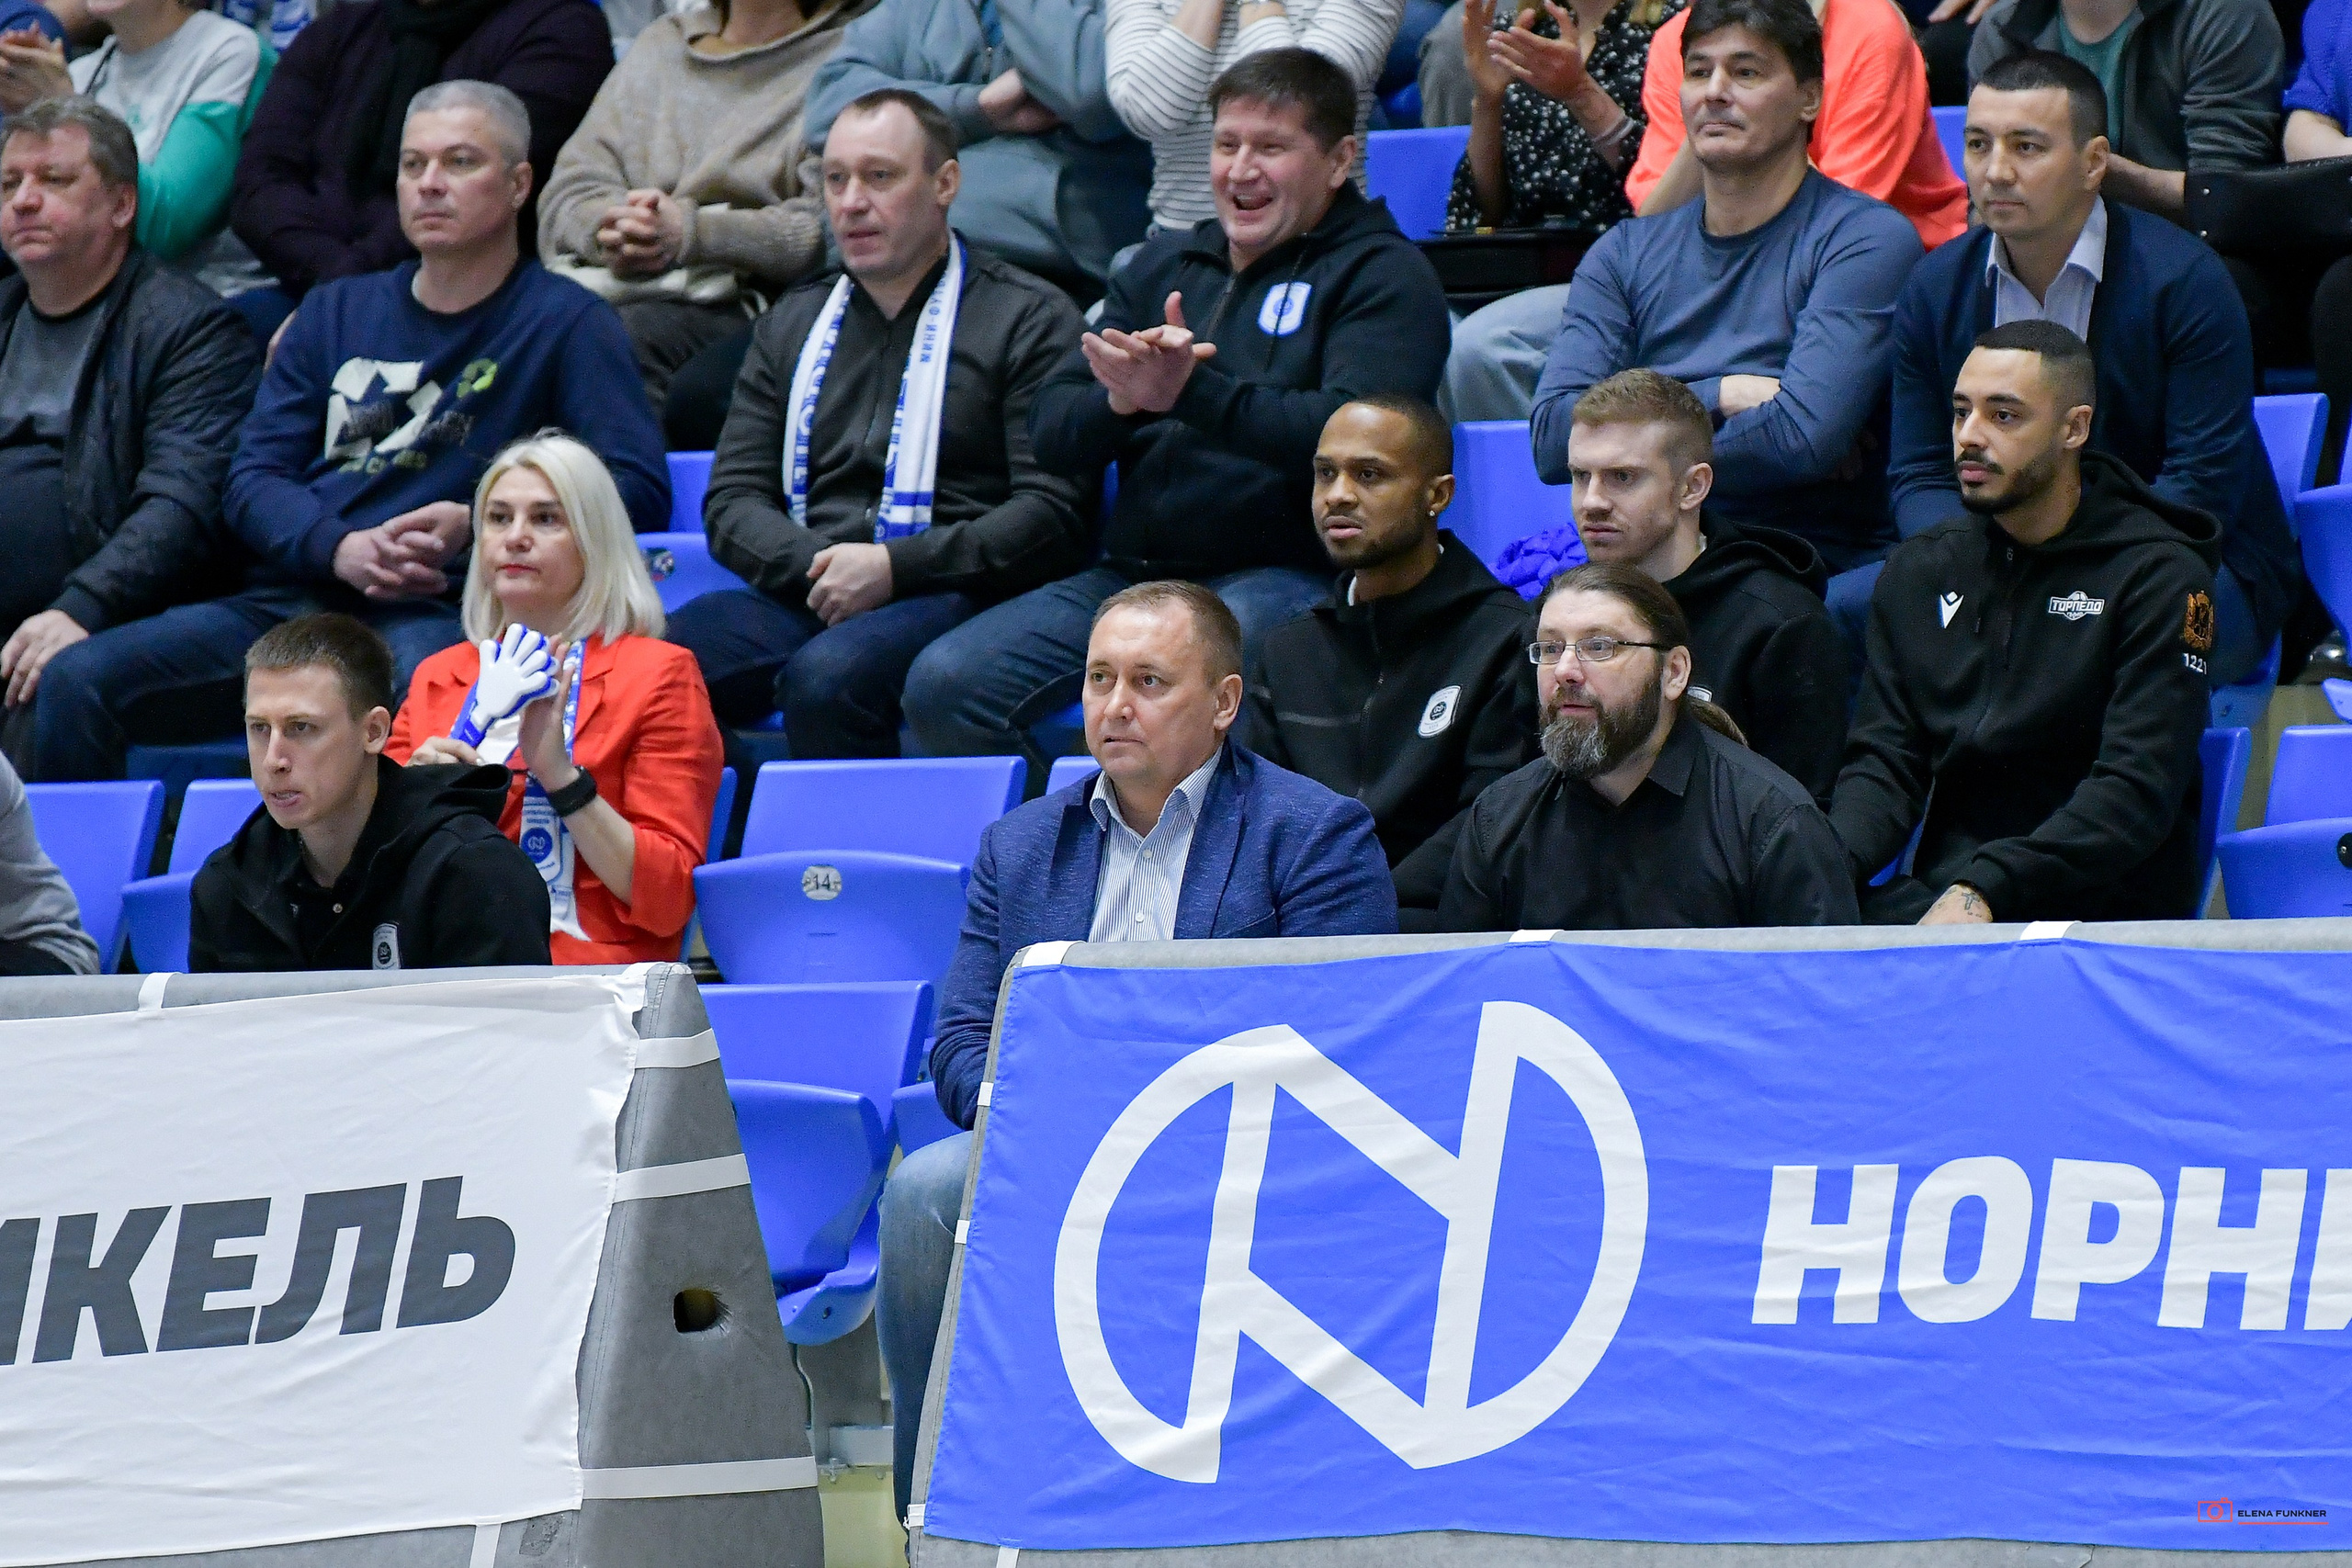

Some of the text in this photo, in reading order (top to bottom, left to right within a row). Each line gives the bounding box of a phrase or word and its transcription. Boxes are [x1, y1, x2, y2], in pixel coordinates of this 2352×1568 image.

[2052, 599, 2103, 612] ТОРПЕДО
[2182, 652, 2207, 675] 1221
[813, 874, 831, 891] 14
